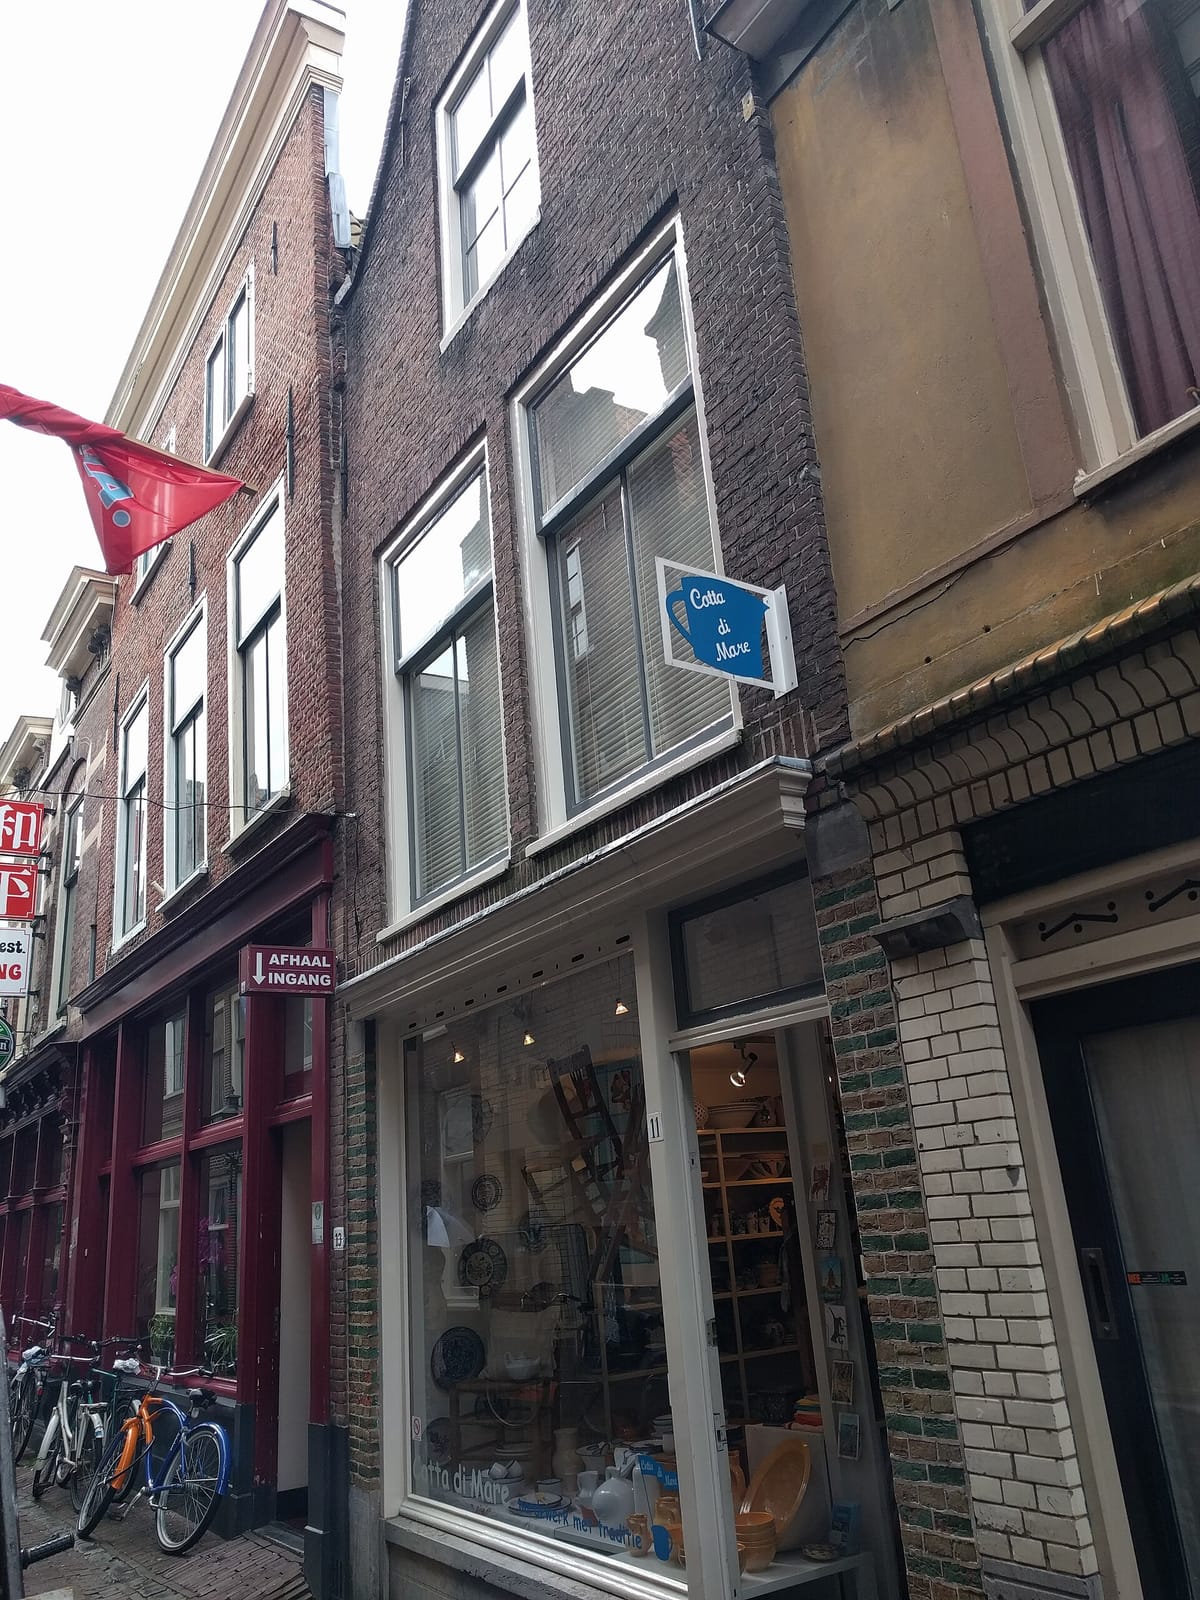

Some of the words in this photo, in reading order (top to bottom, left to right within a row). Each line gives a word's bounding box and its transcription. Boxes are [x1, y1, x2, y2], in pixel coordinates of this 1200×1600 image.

[690, 588, 726, 609] Cotta
[717, 618, 731, 635] di
[716, 641, 751, 661] Mare
[268, 953, 331, 968] AFHAAL
[268, 972, 331, 986] INGANG
[650, 1116, 660, 1139] 11
[453, 1463, 466, 1494] di
[471, 1467, 509, 1505] Mare
